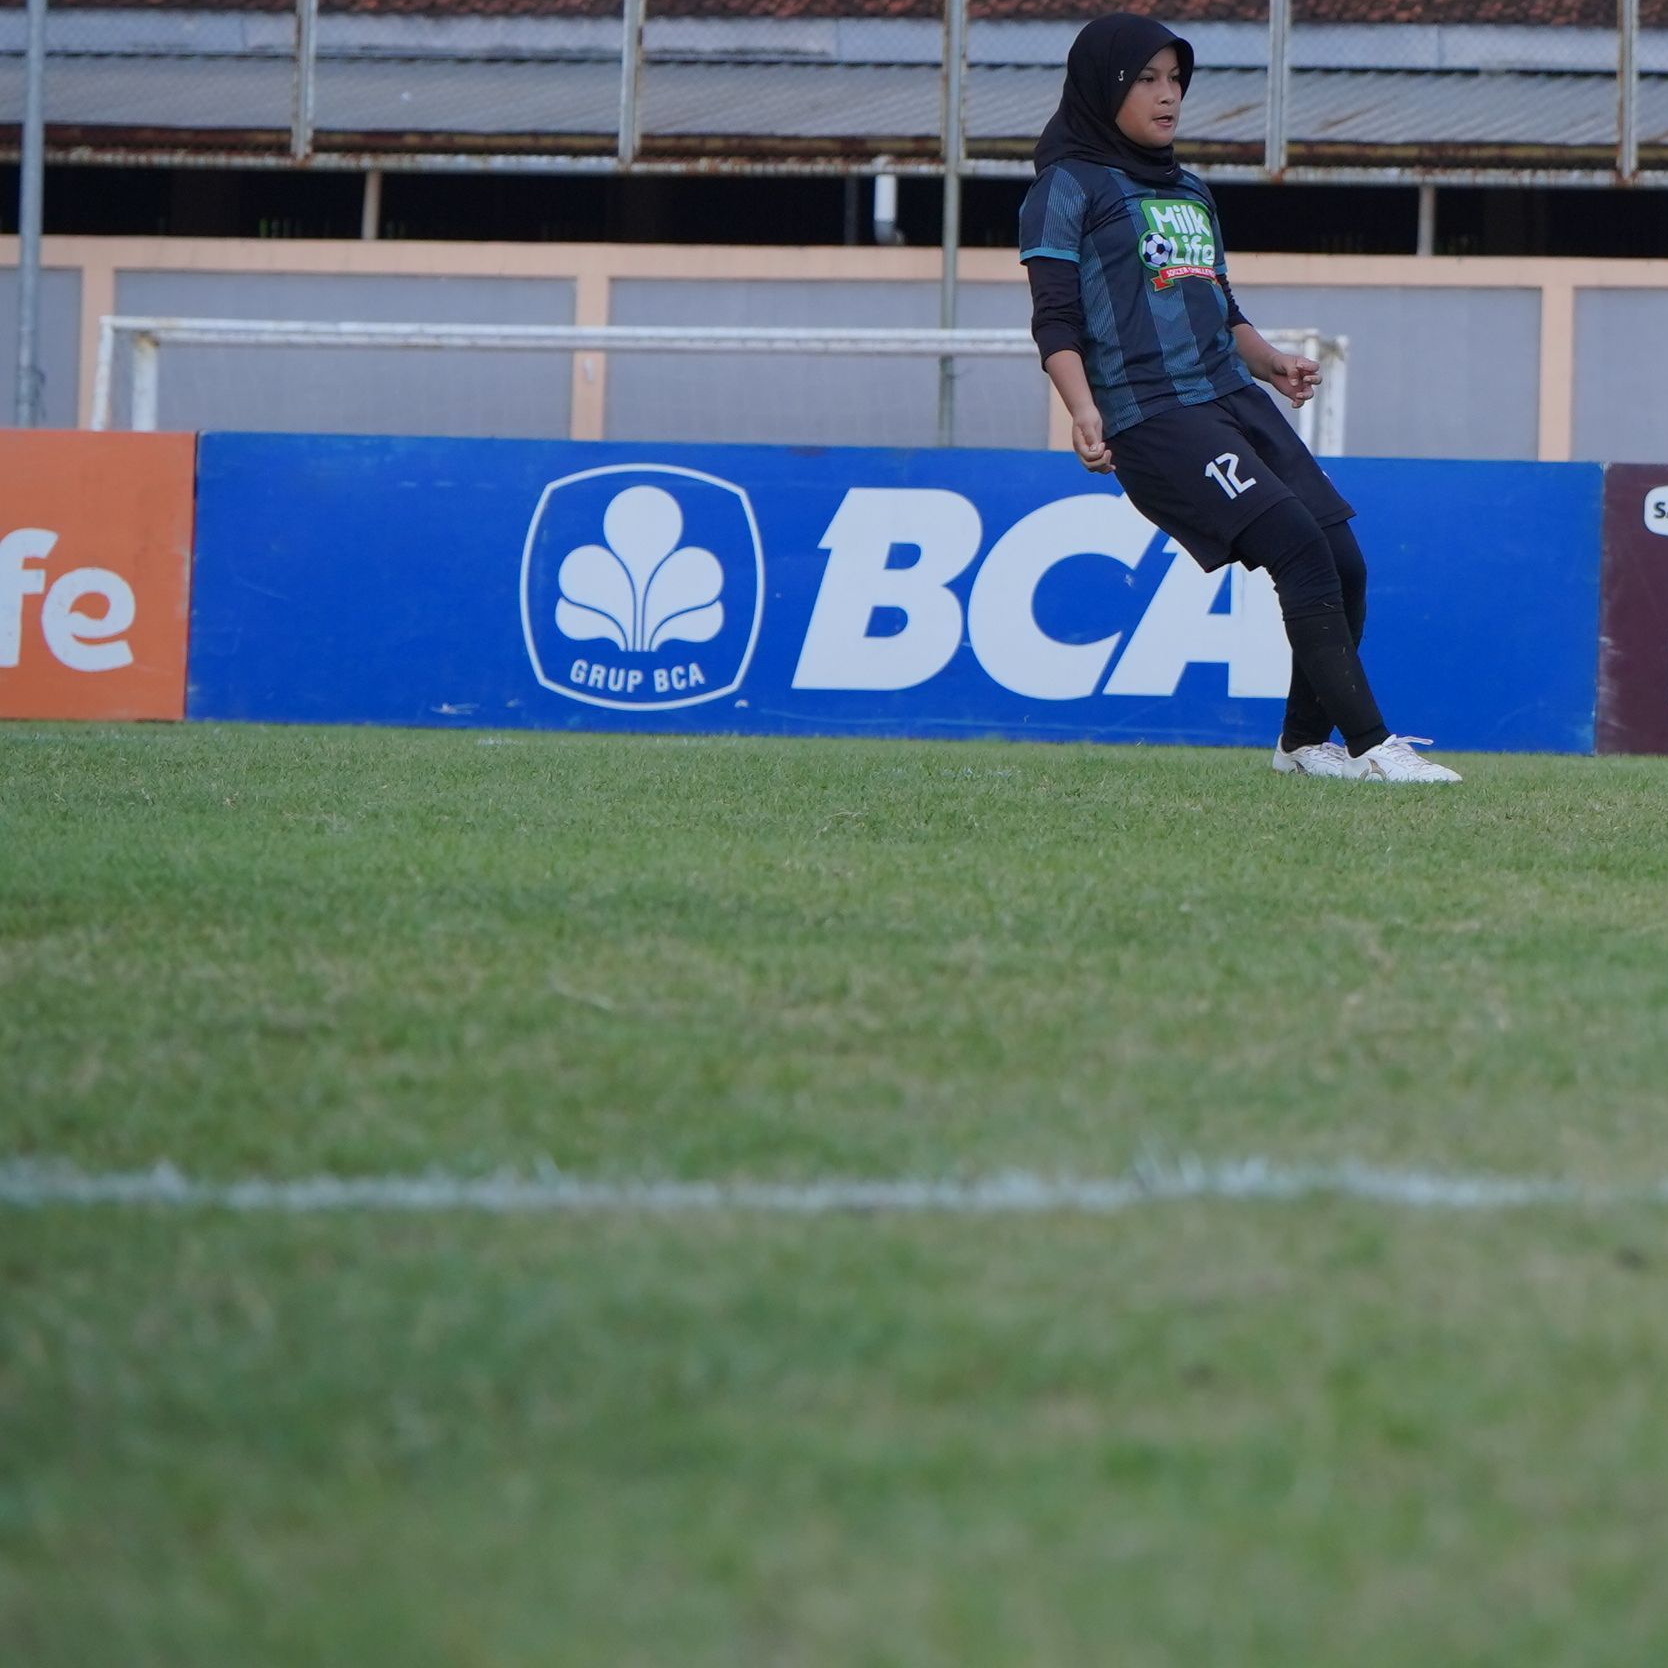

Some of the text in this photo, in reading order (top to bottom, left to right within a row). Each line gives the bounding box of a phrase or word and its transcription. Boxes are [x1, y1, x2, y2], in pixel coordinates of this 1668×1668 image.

[1150, 204, 1211, 237] Milk
[1169, 235, 1215, 265] Life
[1205, 452, 1257, 500] 12
[791, 486, 1292, 701] BCA
[570, 657, 706, 694] GRUP BCA
